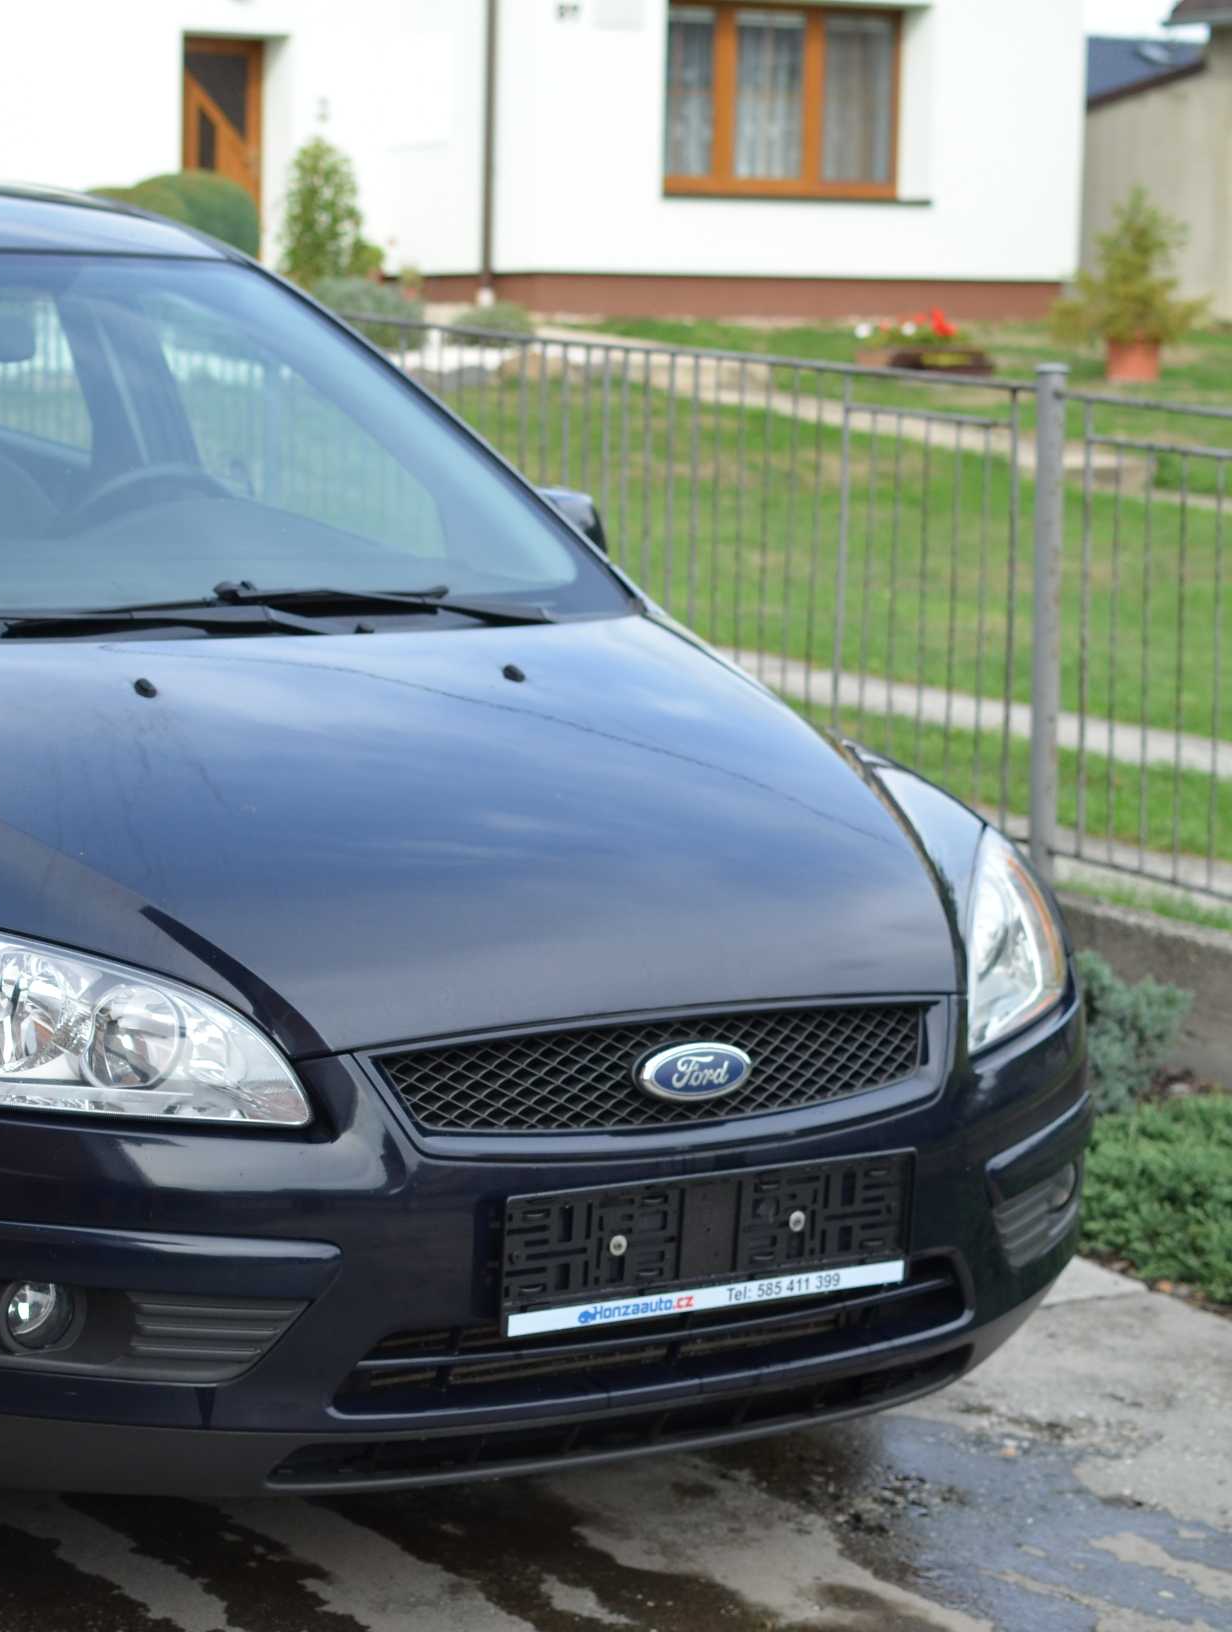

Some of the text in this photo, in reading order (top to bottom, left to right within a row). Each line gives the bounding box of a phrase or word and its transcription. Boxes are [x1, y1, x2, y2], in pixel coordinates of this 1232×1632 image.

[671, 1055, 729, 1088] Ford
[593, 1273, 841, 1320] Honzaauto.cz Tel: 585 411 399
